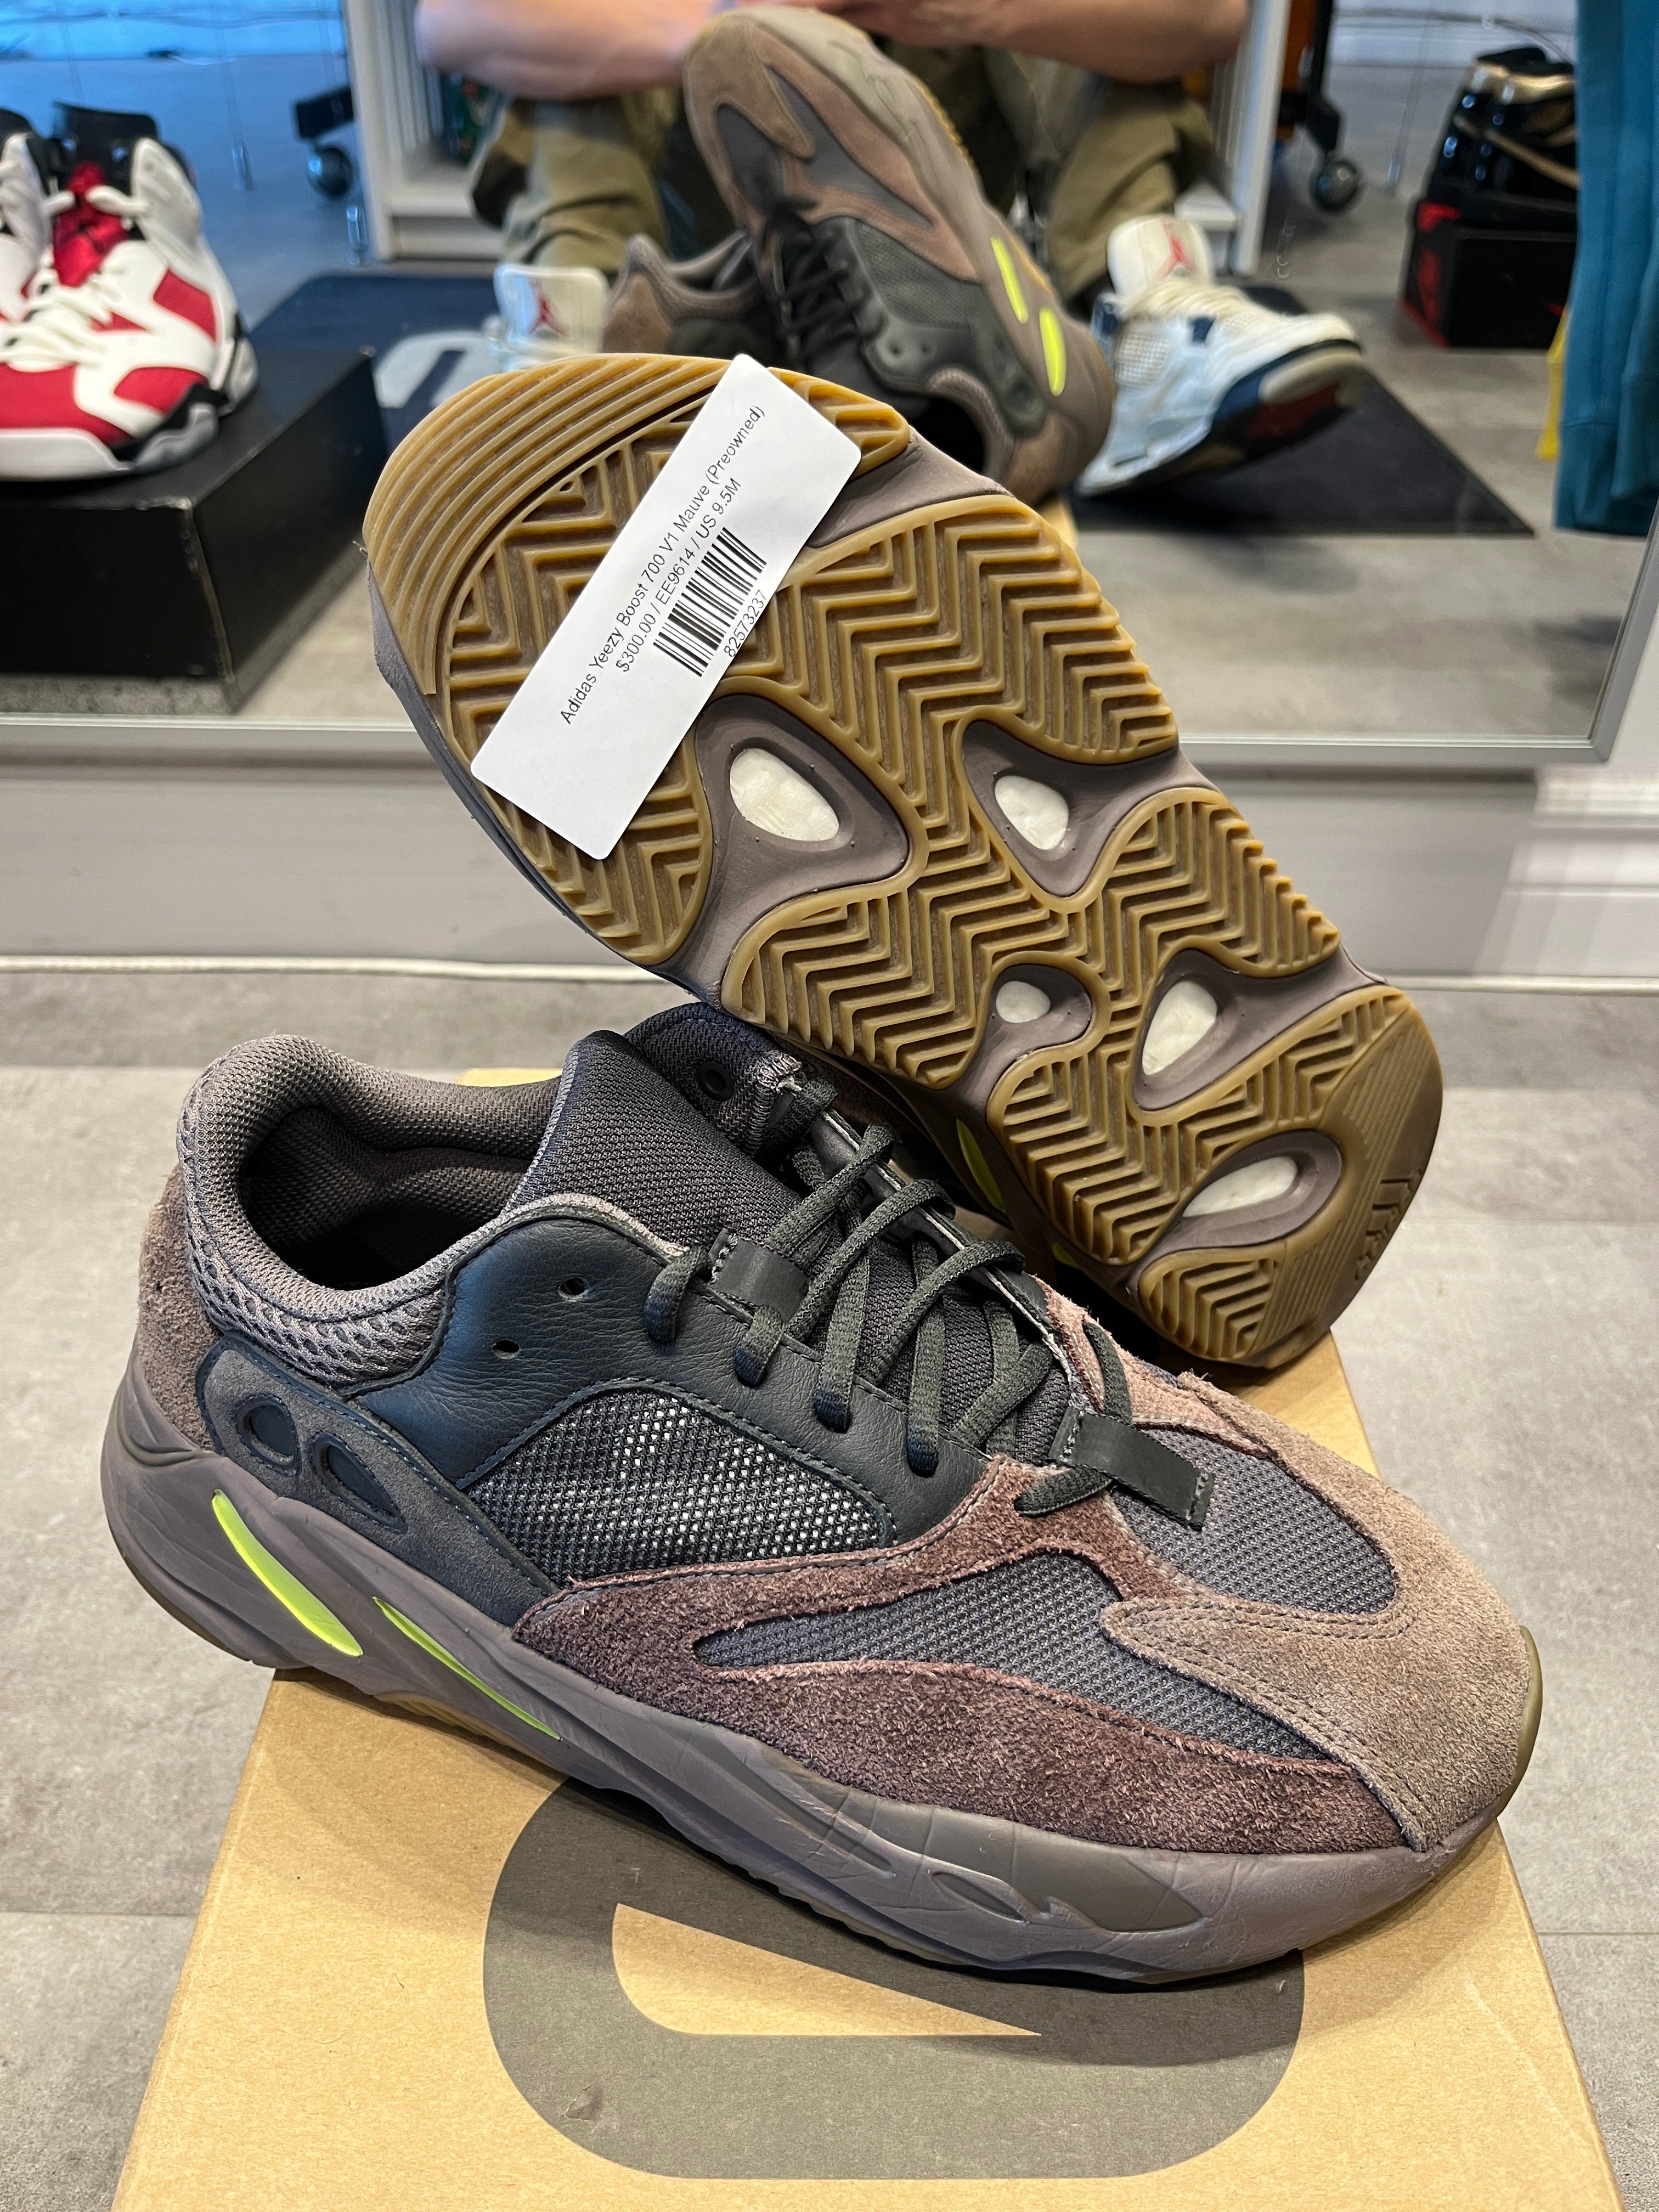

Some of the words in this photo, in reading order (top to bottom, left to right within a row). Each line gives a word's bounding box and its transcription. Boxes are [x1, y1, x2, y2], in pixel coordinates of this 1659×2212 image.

[712, 477, 741, 515] 9.5M
[690, 537, 701, 550] /
[696, 515, 716, 539] US
[561, 674, 596, 725] Adidas
[589, 627, 624, 669] Yeezy
[616, 583, 648, 627] Boost
[641, 554, 665, 583] 700
[658, 532, 679, 552] V1
[673, 486, 710, 532] Mauve
[706, 405, 765, 485] (Preowned)
[655, 548, 695, 605] EE9614
[651, 602, 662, 615] /
[724, 589, 766, 657] 82573237
[616, 612, 657, 673] $300.00
